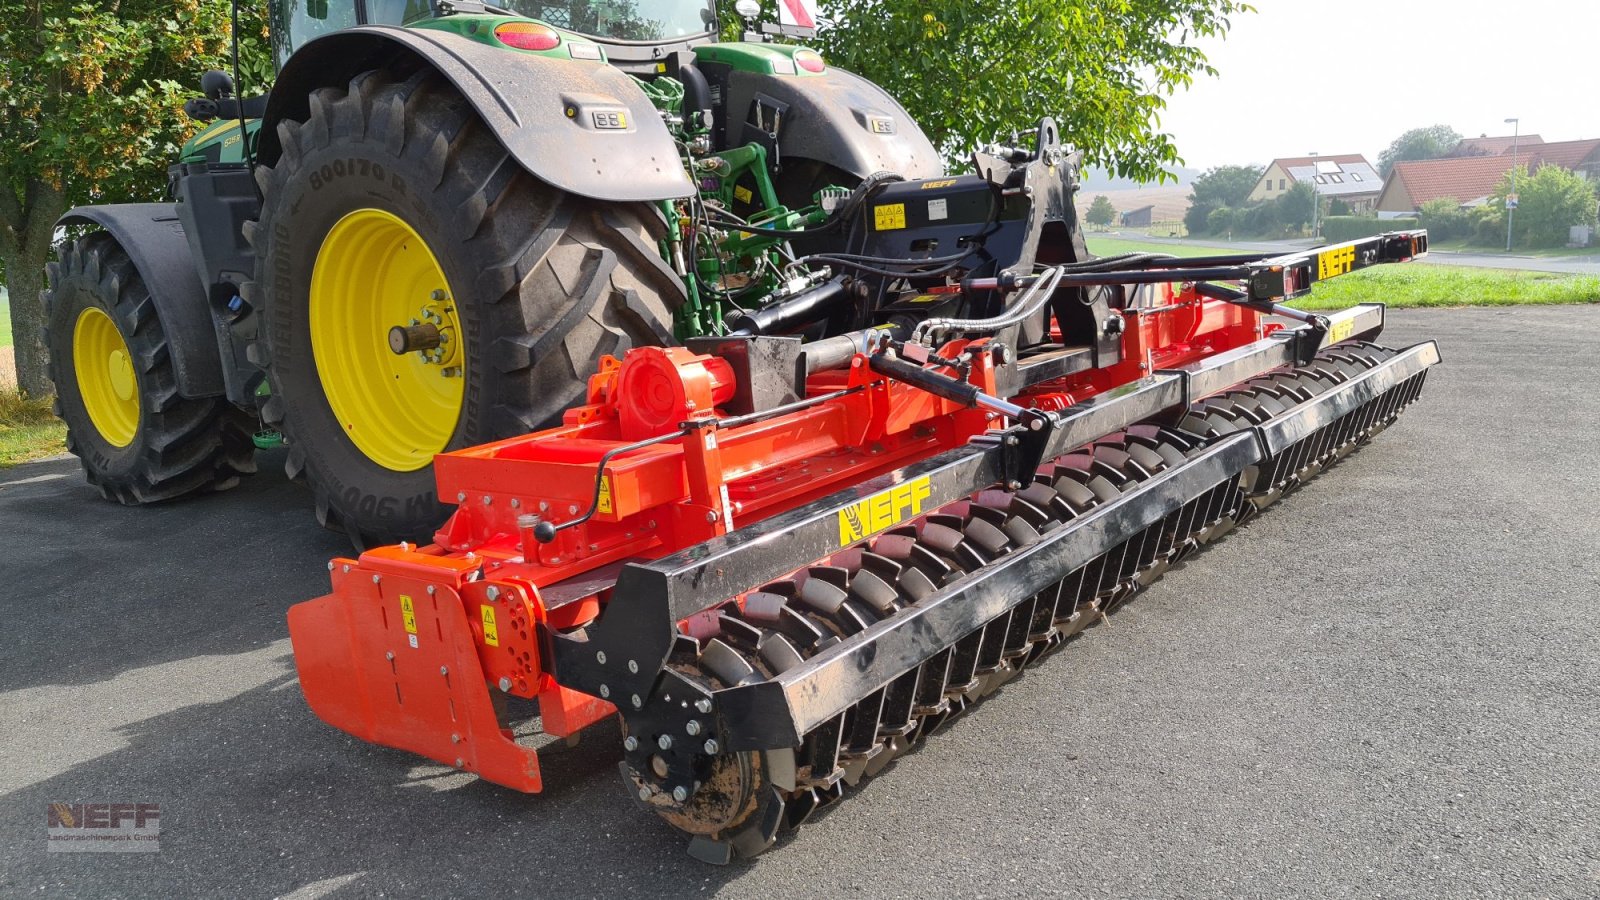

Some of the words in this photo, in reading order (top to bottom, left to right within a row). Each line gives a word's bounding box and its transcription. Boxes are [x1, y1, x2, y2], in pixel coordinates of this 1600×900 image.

[308, 158, 386, 191] 800/70
[920, 179, 957, 190] NEFF
[1318, 244, 1356, 281] NEFF
[274, 222, 293, 375] TRELLEBORG
[1329, 317, 1354, 345] NEFF
[343, 485, 399, 519] 900
[838, 474, 931, 548] NEFF
